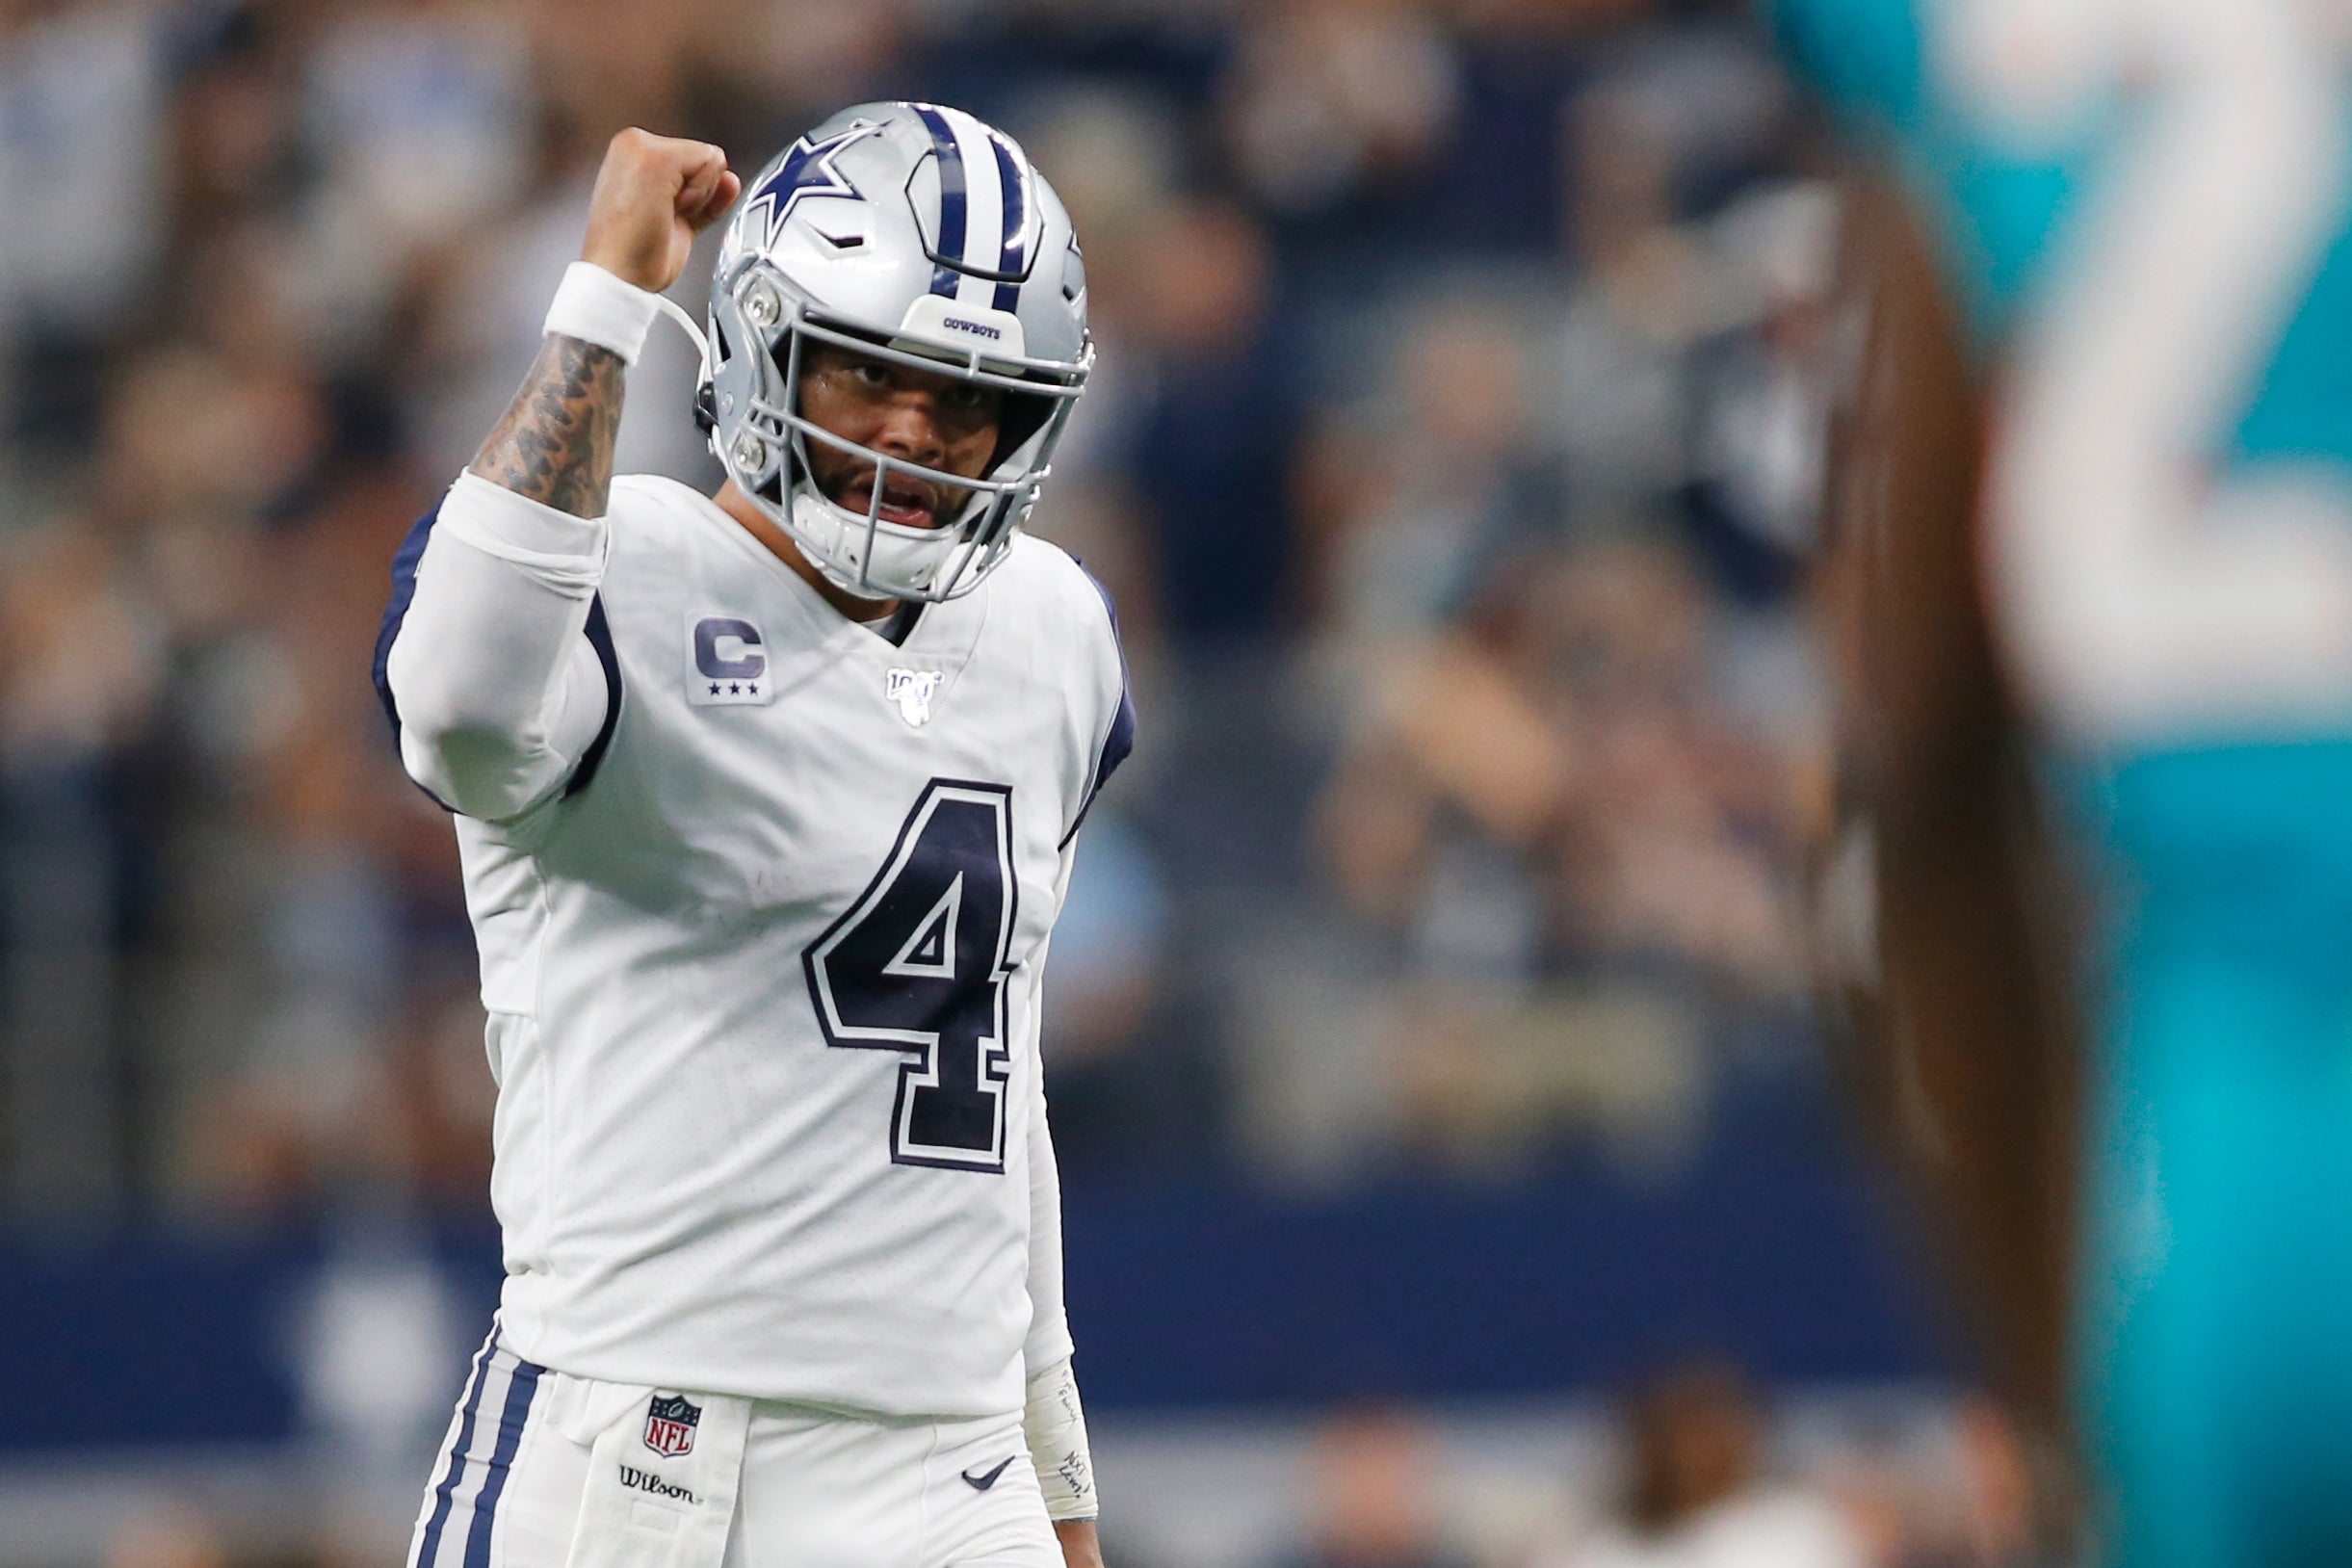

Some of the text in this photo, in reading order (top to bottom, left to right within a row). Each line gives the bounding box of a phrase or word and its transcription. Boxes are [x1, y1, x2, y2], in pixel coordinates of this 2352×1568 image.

[944, 318, 1001, 340] COWBOYS
[694, 616, 766, 679] C
[801, 776, 1019, 1174] 4
[647, 1418, 690, 1452] NFL
[619, 1464, 694, 1503] Wilson
